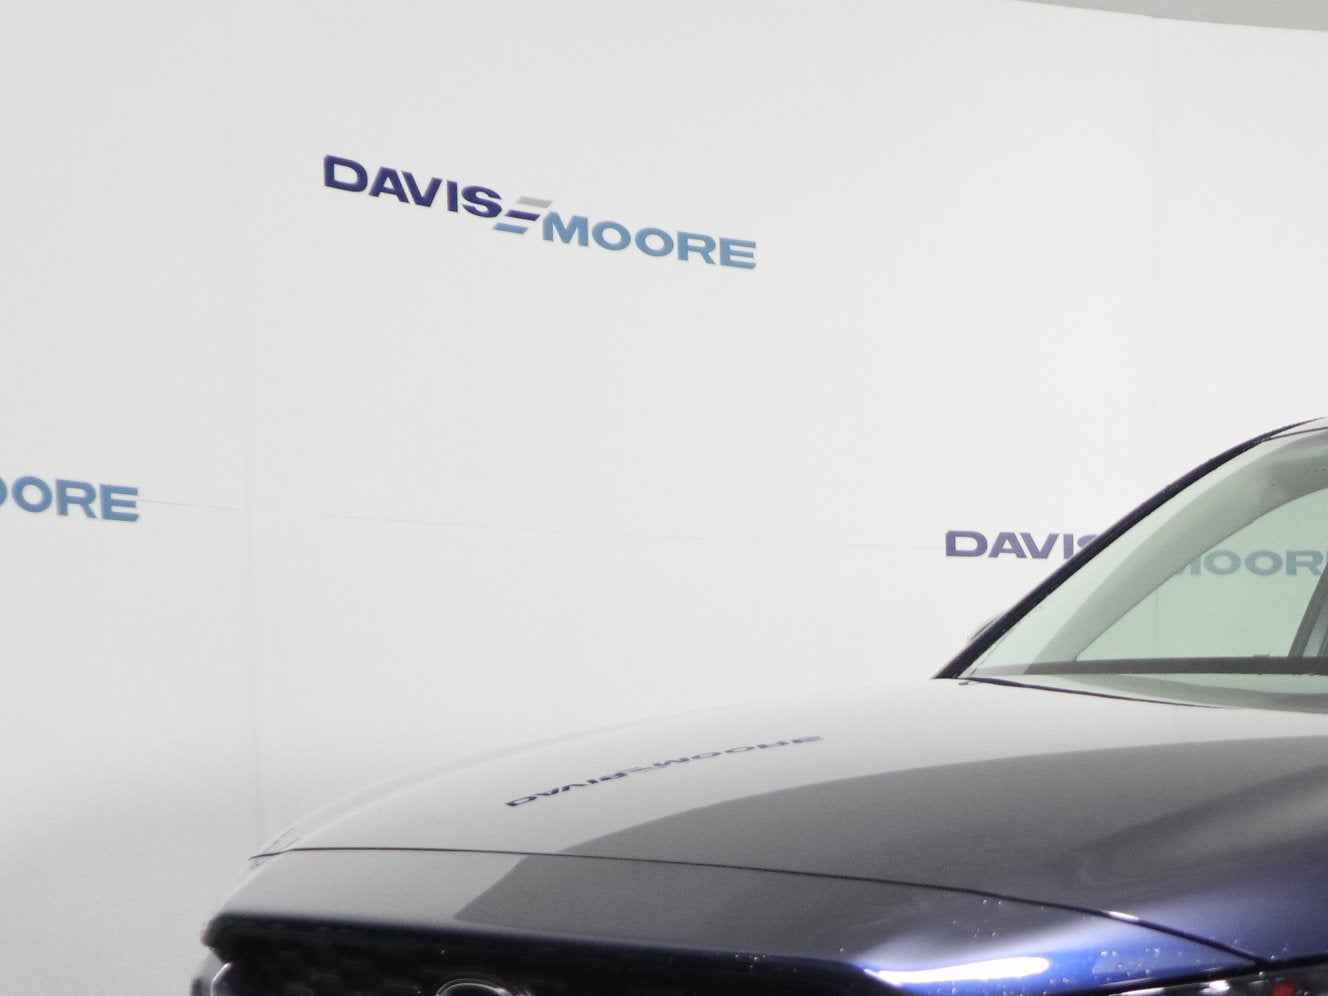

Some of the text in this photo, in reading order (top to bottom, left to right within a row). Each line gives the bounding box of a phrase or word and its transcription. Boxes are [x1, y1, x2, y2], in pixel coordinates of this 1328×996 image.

[323, 154, 757, 269] DAVIS MOORE
[0, 475, 140, 522] ORE
[945, 530, 1098, 560] DAVI
